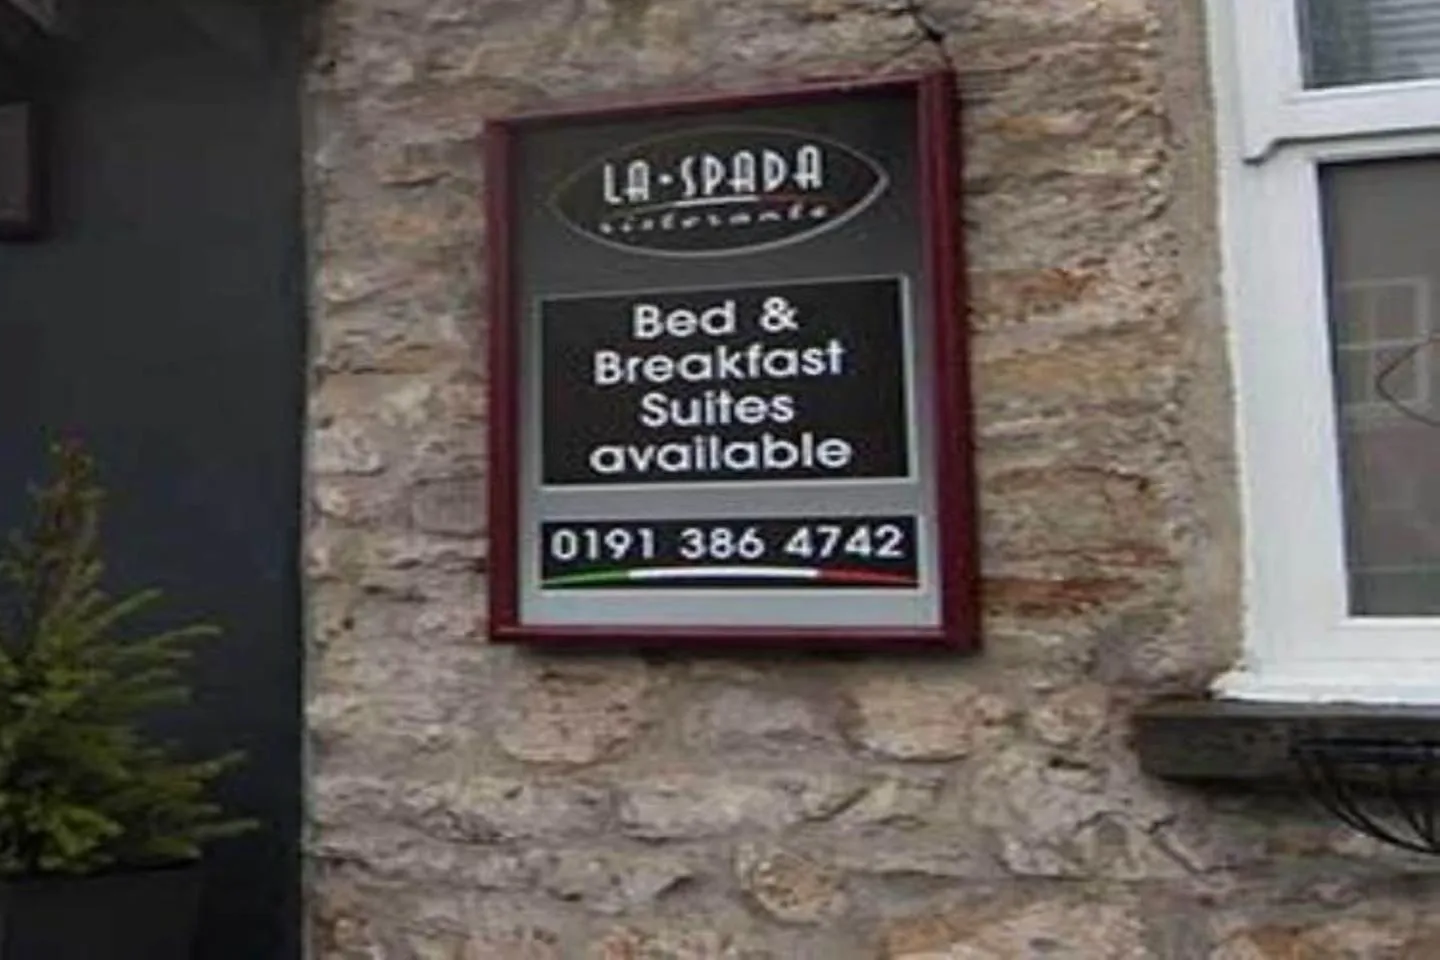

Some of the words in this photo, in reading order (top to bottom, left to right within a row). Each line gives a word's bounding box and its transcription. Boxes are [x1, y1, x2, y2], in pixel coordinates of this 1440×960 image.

[603, 159, 649, 203] LA
[680, 144, 823, 198] SPADA
[633, 300, 736, 340] Bed
[760, 296, 799, 333] &
[594, 340, 846, 385] Breakfast
[641, 389, 796, 428] Suites
[590, 433, 852, 474] available
[551, 528, 655, 561] 0191
[679, 527, 765, 560] 386
[784, 525, 905, 559] 4742
